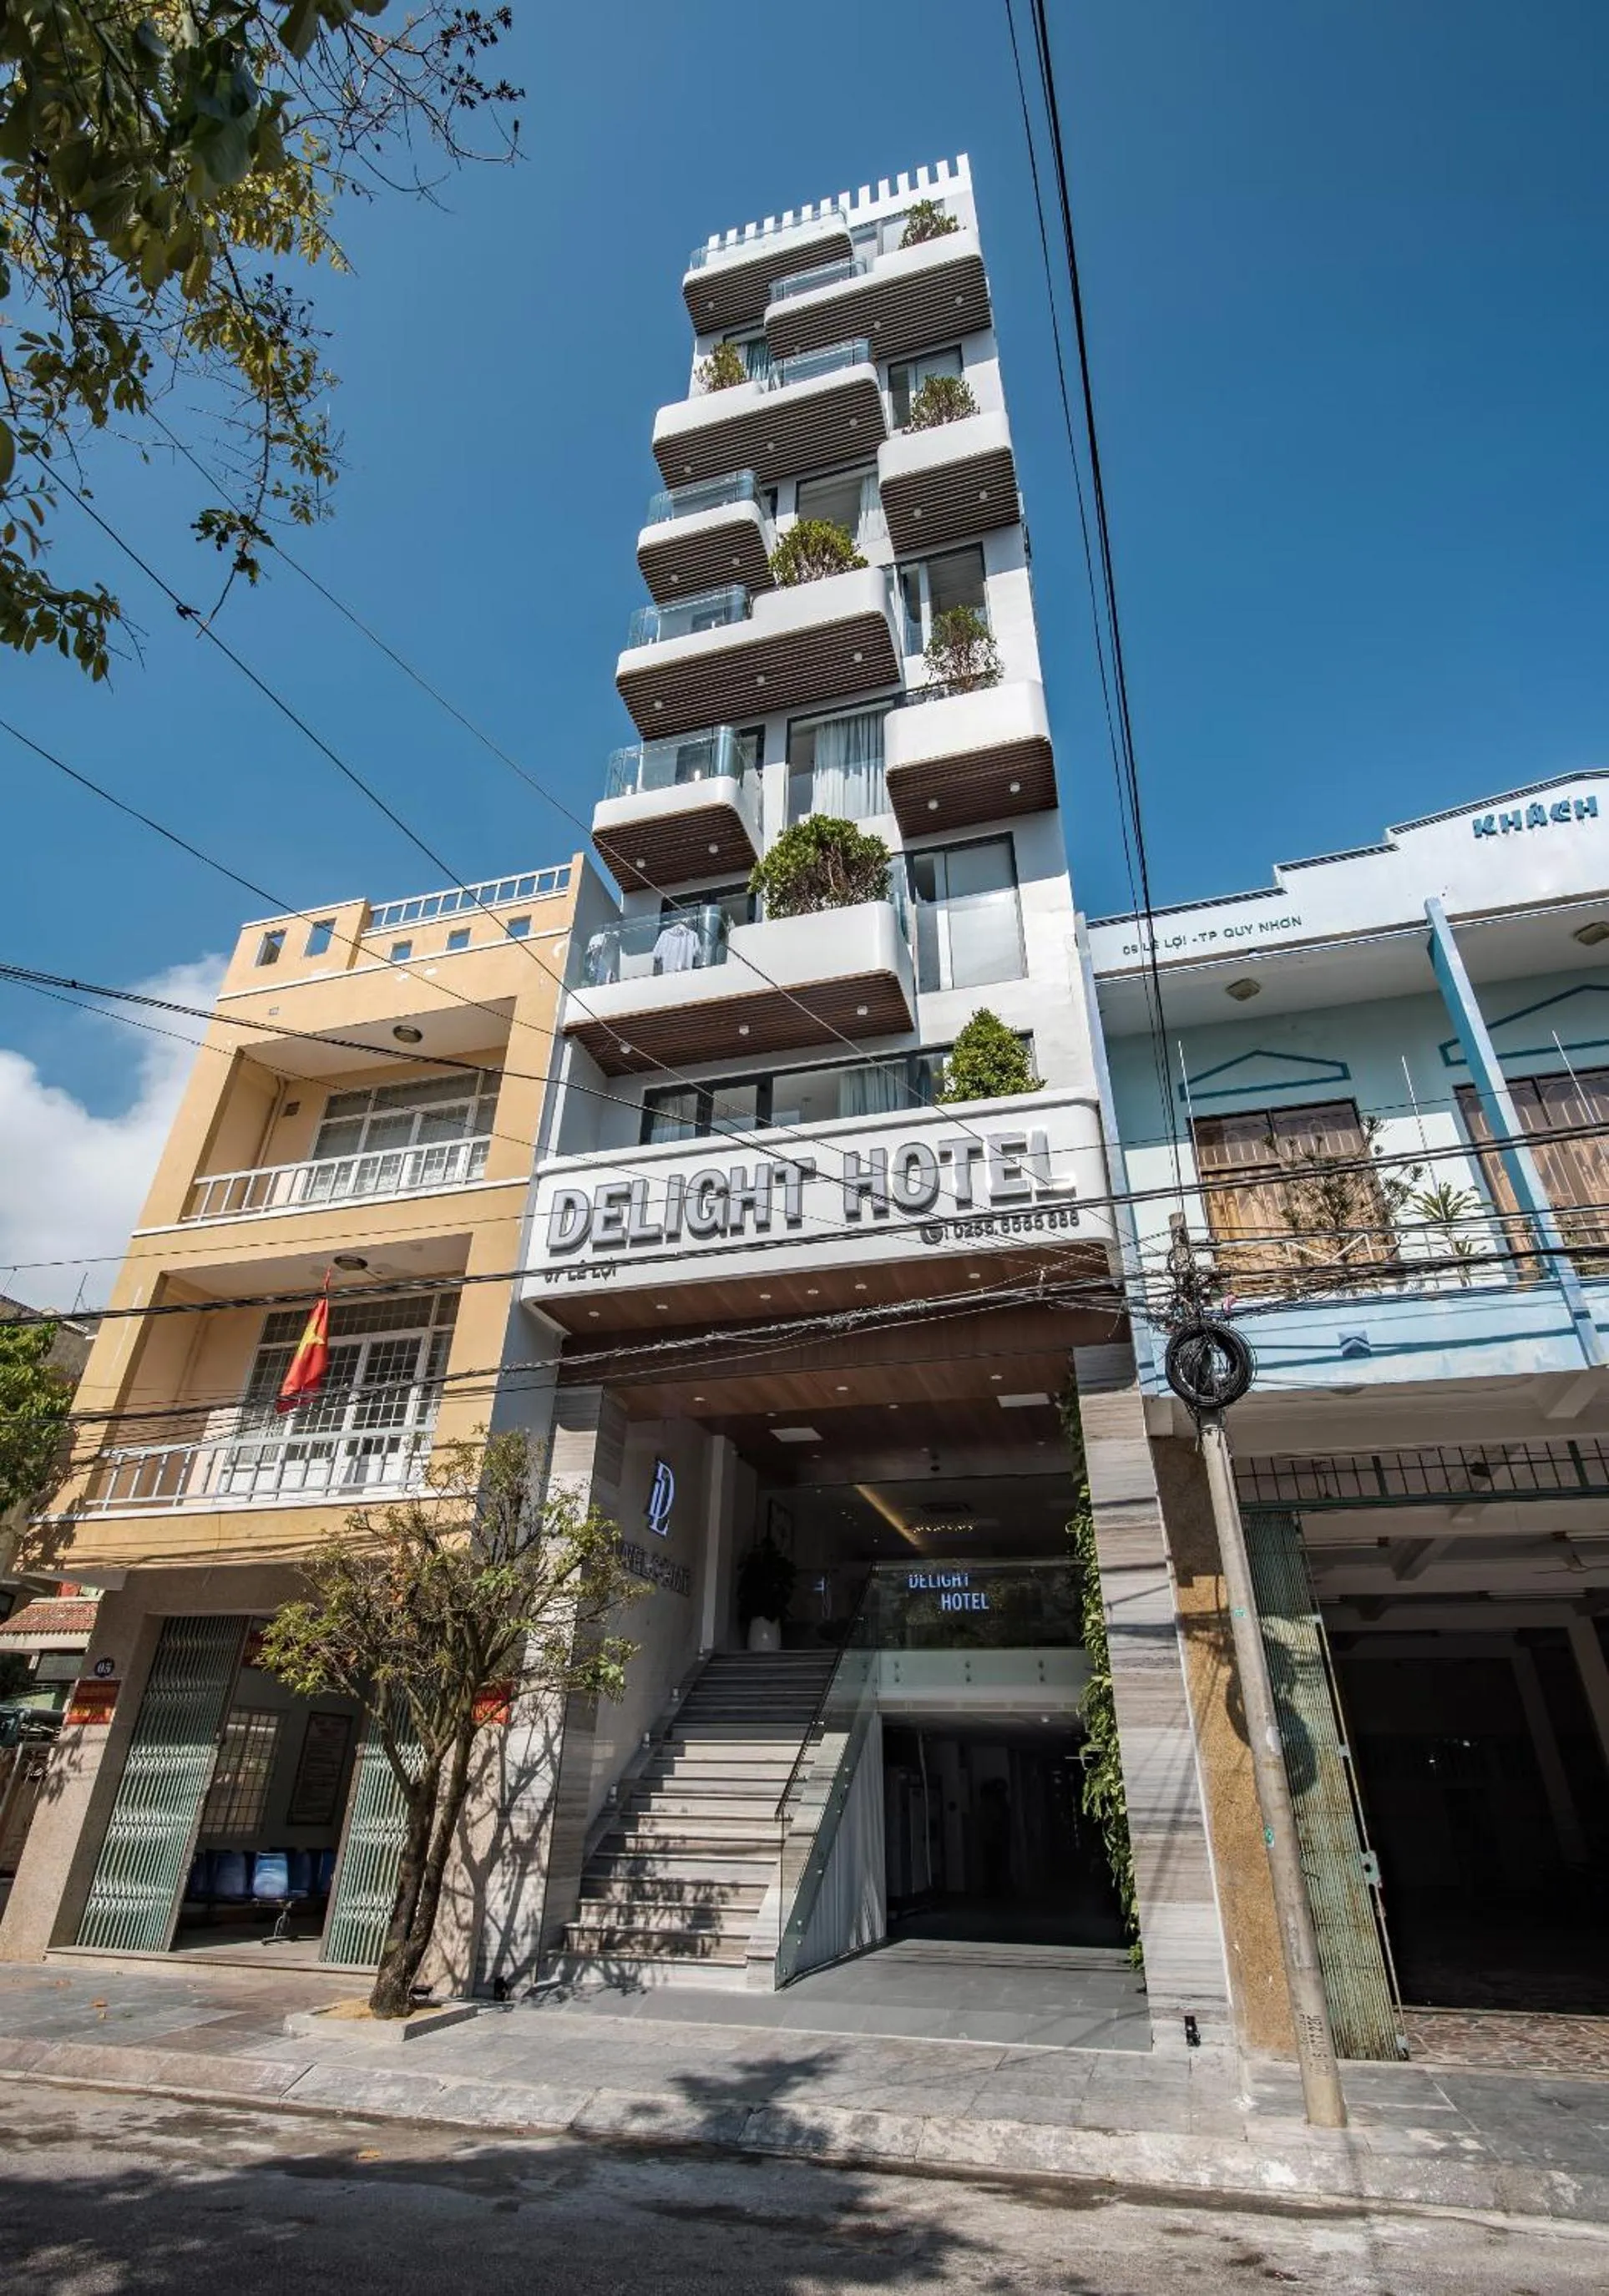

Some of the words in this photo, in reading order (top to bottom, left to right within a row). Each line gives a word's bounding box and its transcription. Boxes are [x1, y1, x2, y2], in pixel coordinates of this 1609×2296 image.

[1472, 796, 1599, 838] KHÁCH
[1224, 924, 1253, 938] QUY
[1258, 916, 1302, 933] NHƠN
[546, 1157, 817, 1257] DELIGHT
[843, 1125, 1077, 1223] HOTEL
[941, 1592, 989, 1611] HOTEL
